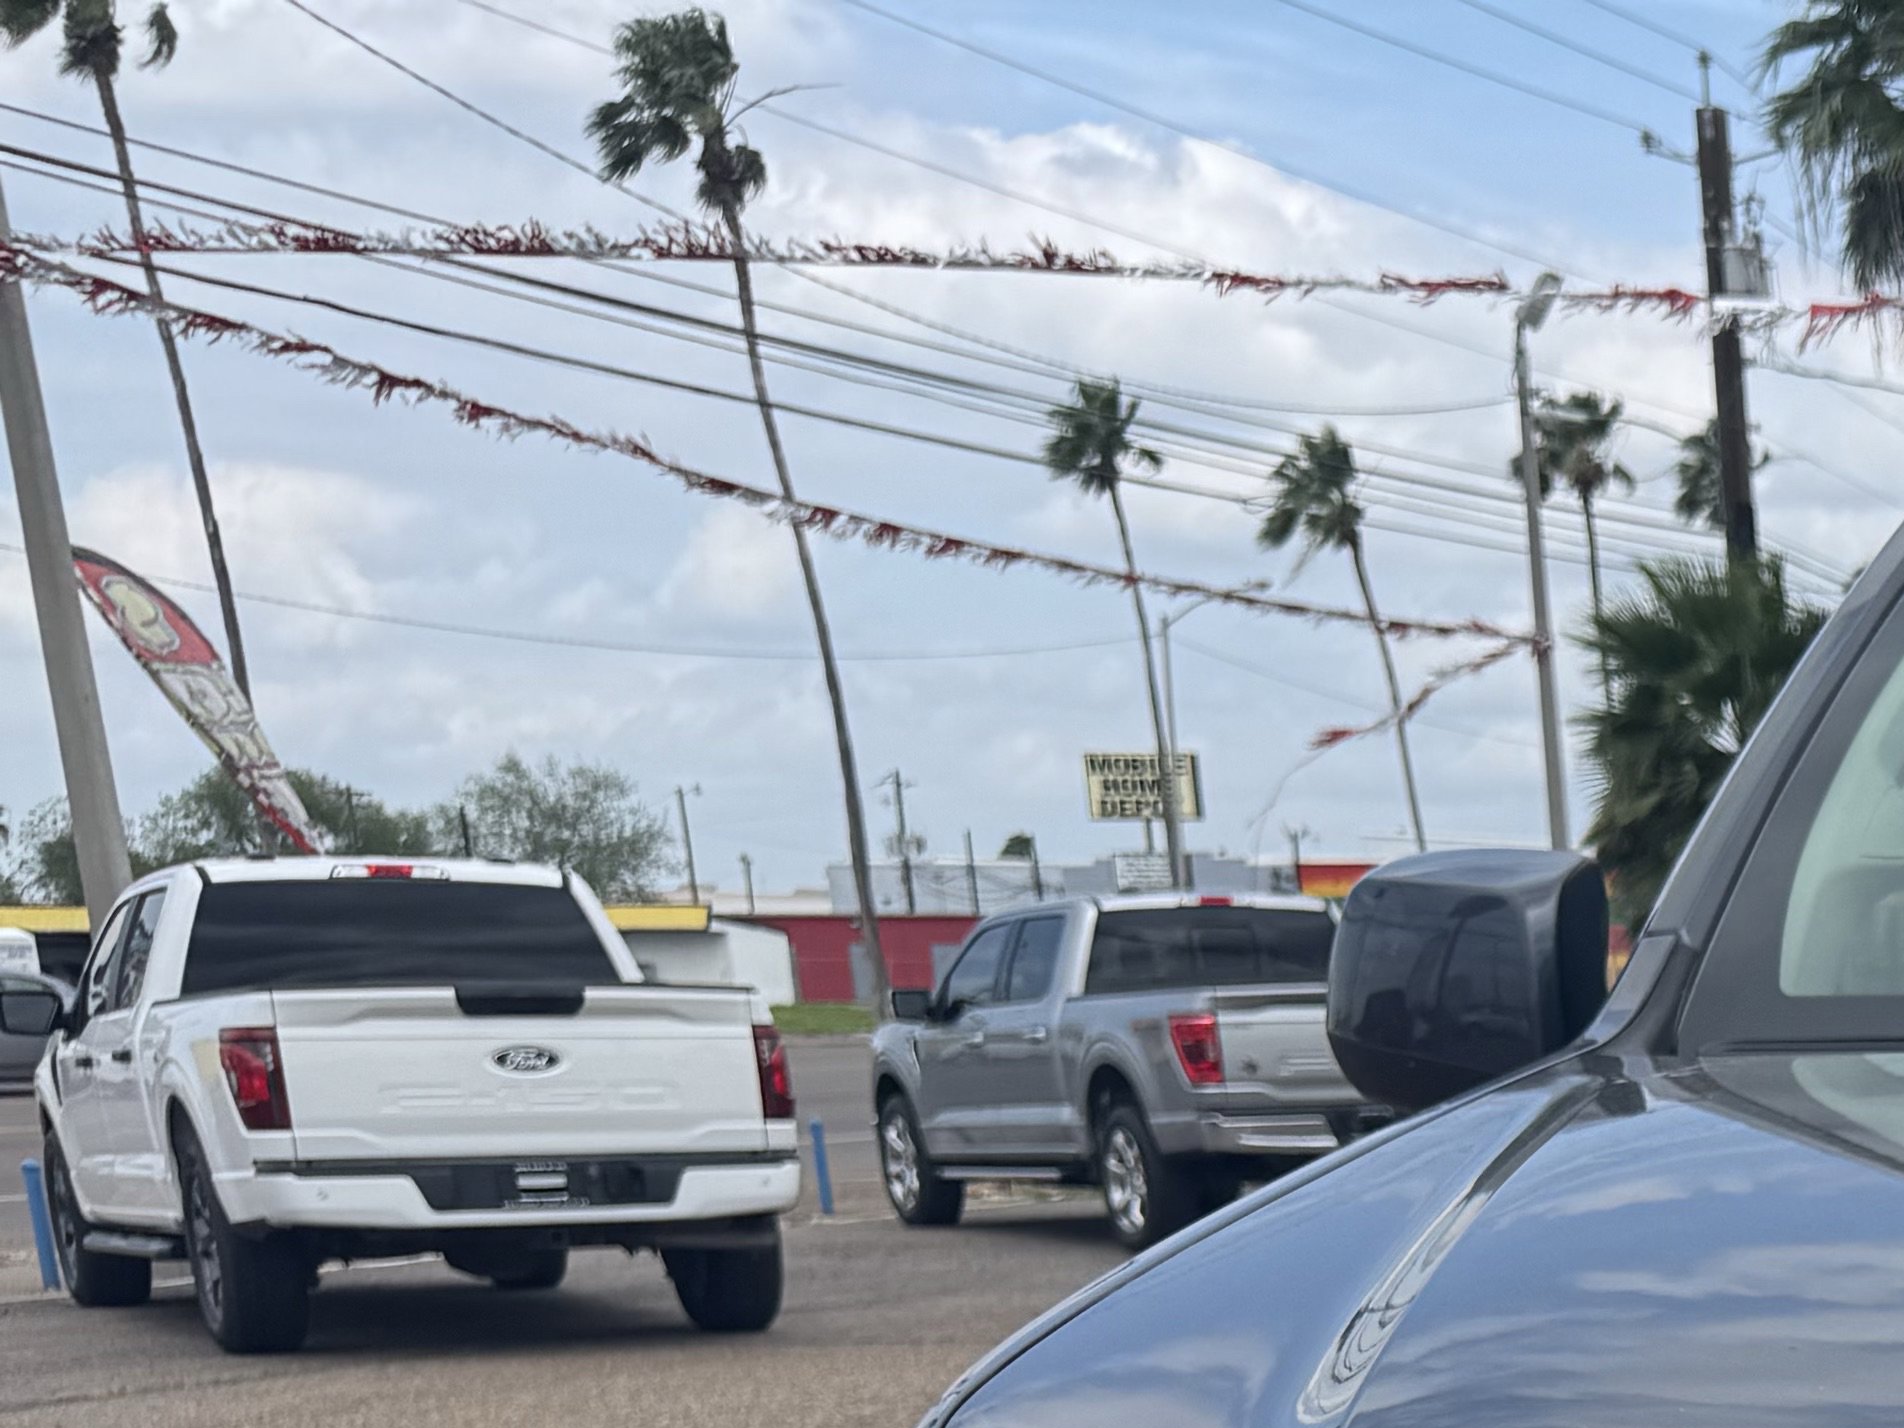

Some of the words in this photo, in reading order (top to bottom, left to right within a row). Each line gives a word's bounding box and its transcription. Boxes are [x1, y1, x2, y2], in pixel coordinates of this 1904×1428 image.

[1089, 758, 1188, 776] MOBIE
[1100, 799, 1165, 817] DEPO
[494, 1049, 551, 1070] Ford
